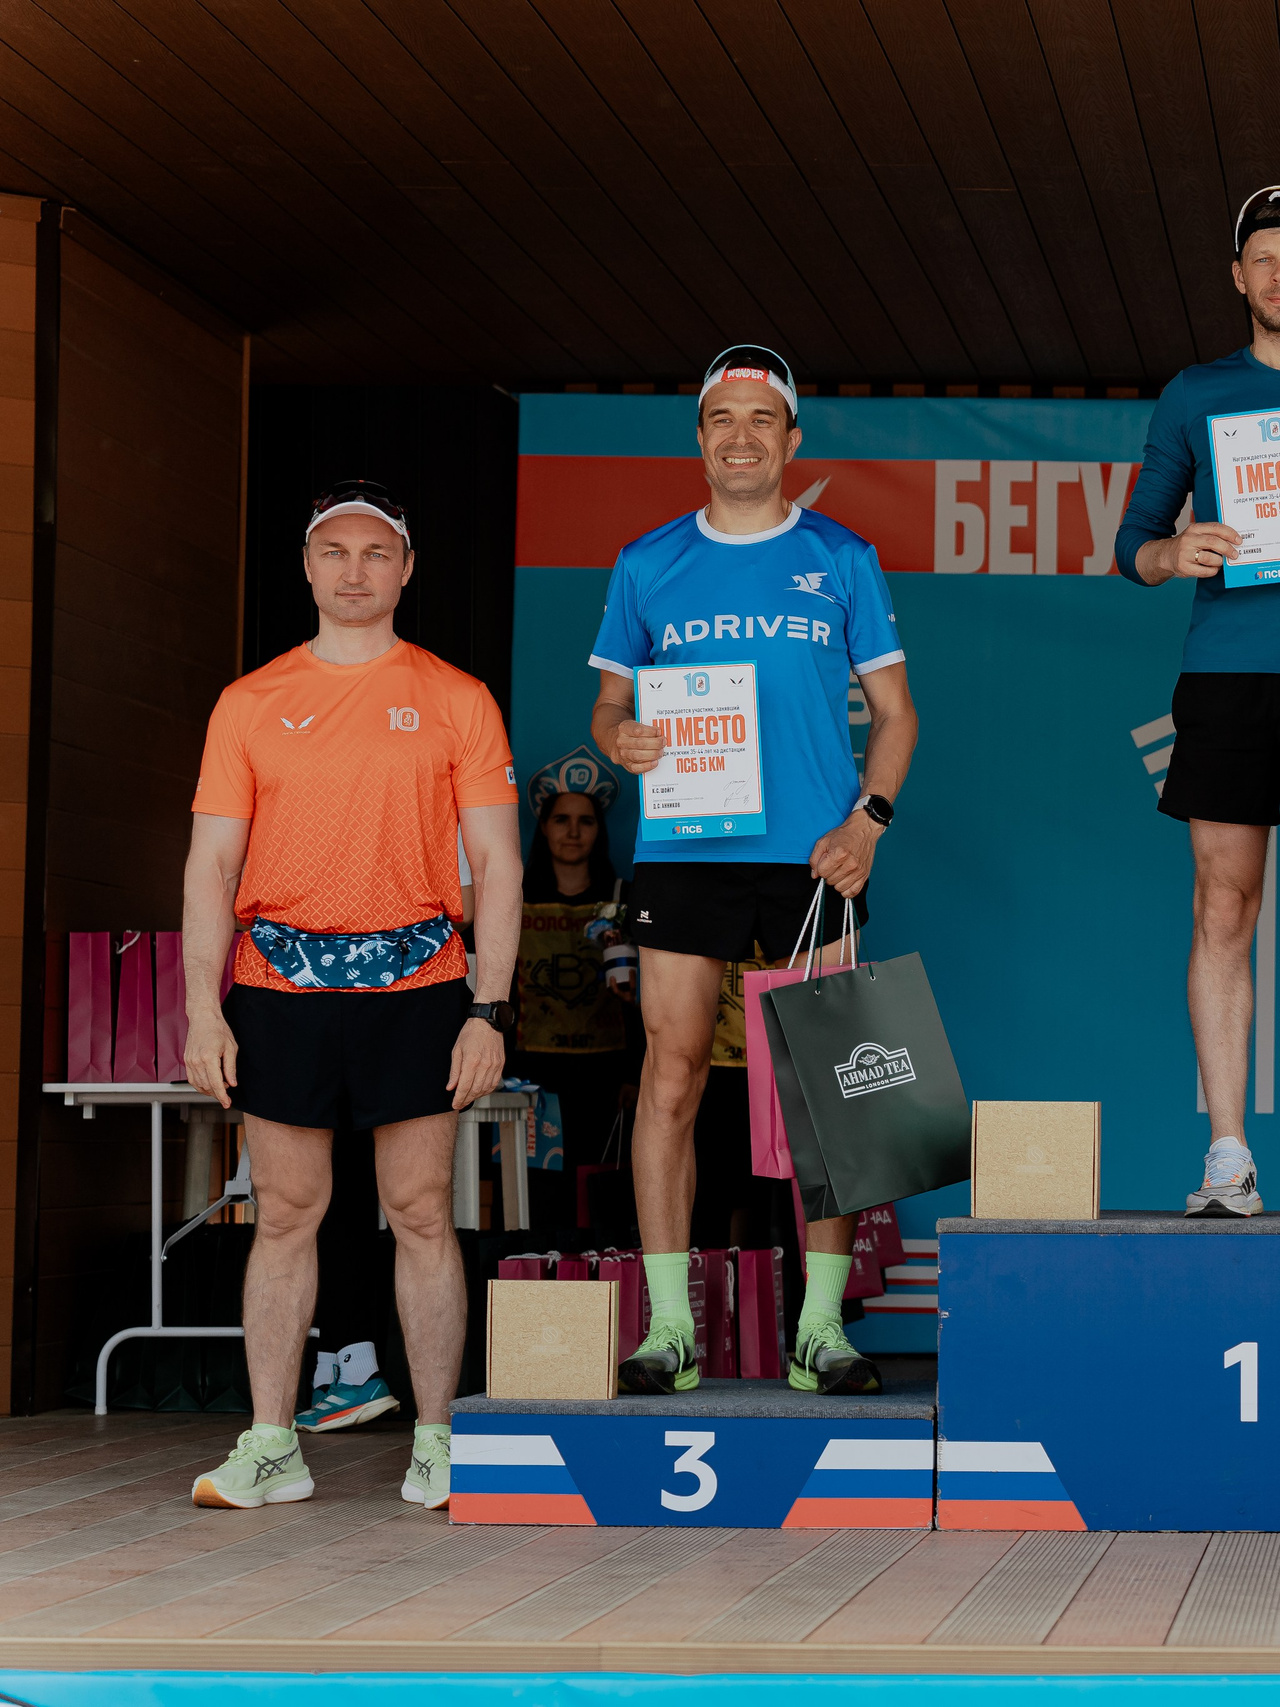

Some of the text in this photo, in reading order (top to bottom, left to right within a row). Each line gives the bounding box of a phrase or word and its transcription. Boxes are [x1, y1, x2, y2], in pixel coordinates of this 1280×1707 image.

[728, 368, 764, 380] WONDER
[1235, 465, 1244, 494] I
[1255, 502, 1277, 519] ПСБ
[662, 614, 831, 651] ADRIVER
[386, 707, 420, 732] 10
[676, 714, 746, 747] МЕСТО
[676, 756, 725, 774] ПСБ 5 КМ
[682, 825, 702, 834] ПСБ
[843, 1059, 909, 1087] AHMAD TEA
[865, 1079, 890, 1089] LONDON
[1224, 1341, 1258, 1423] 1
[660, 1431, 717, 1513] 3
